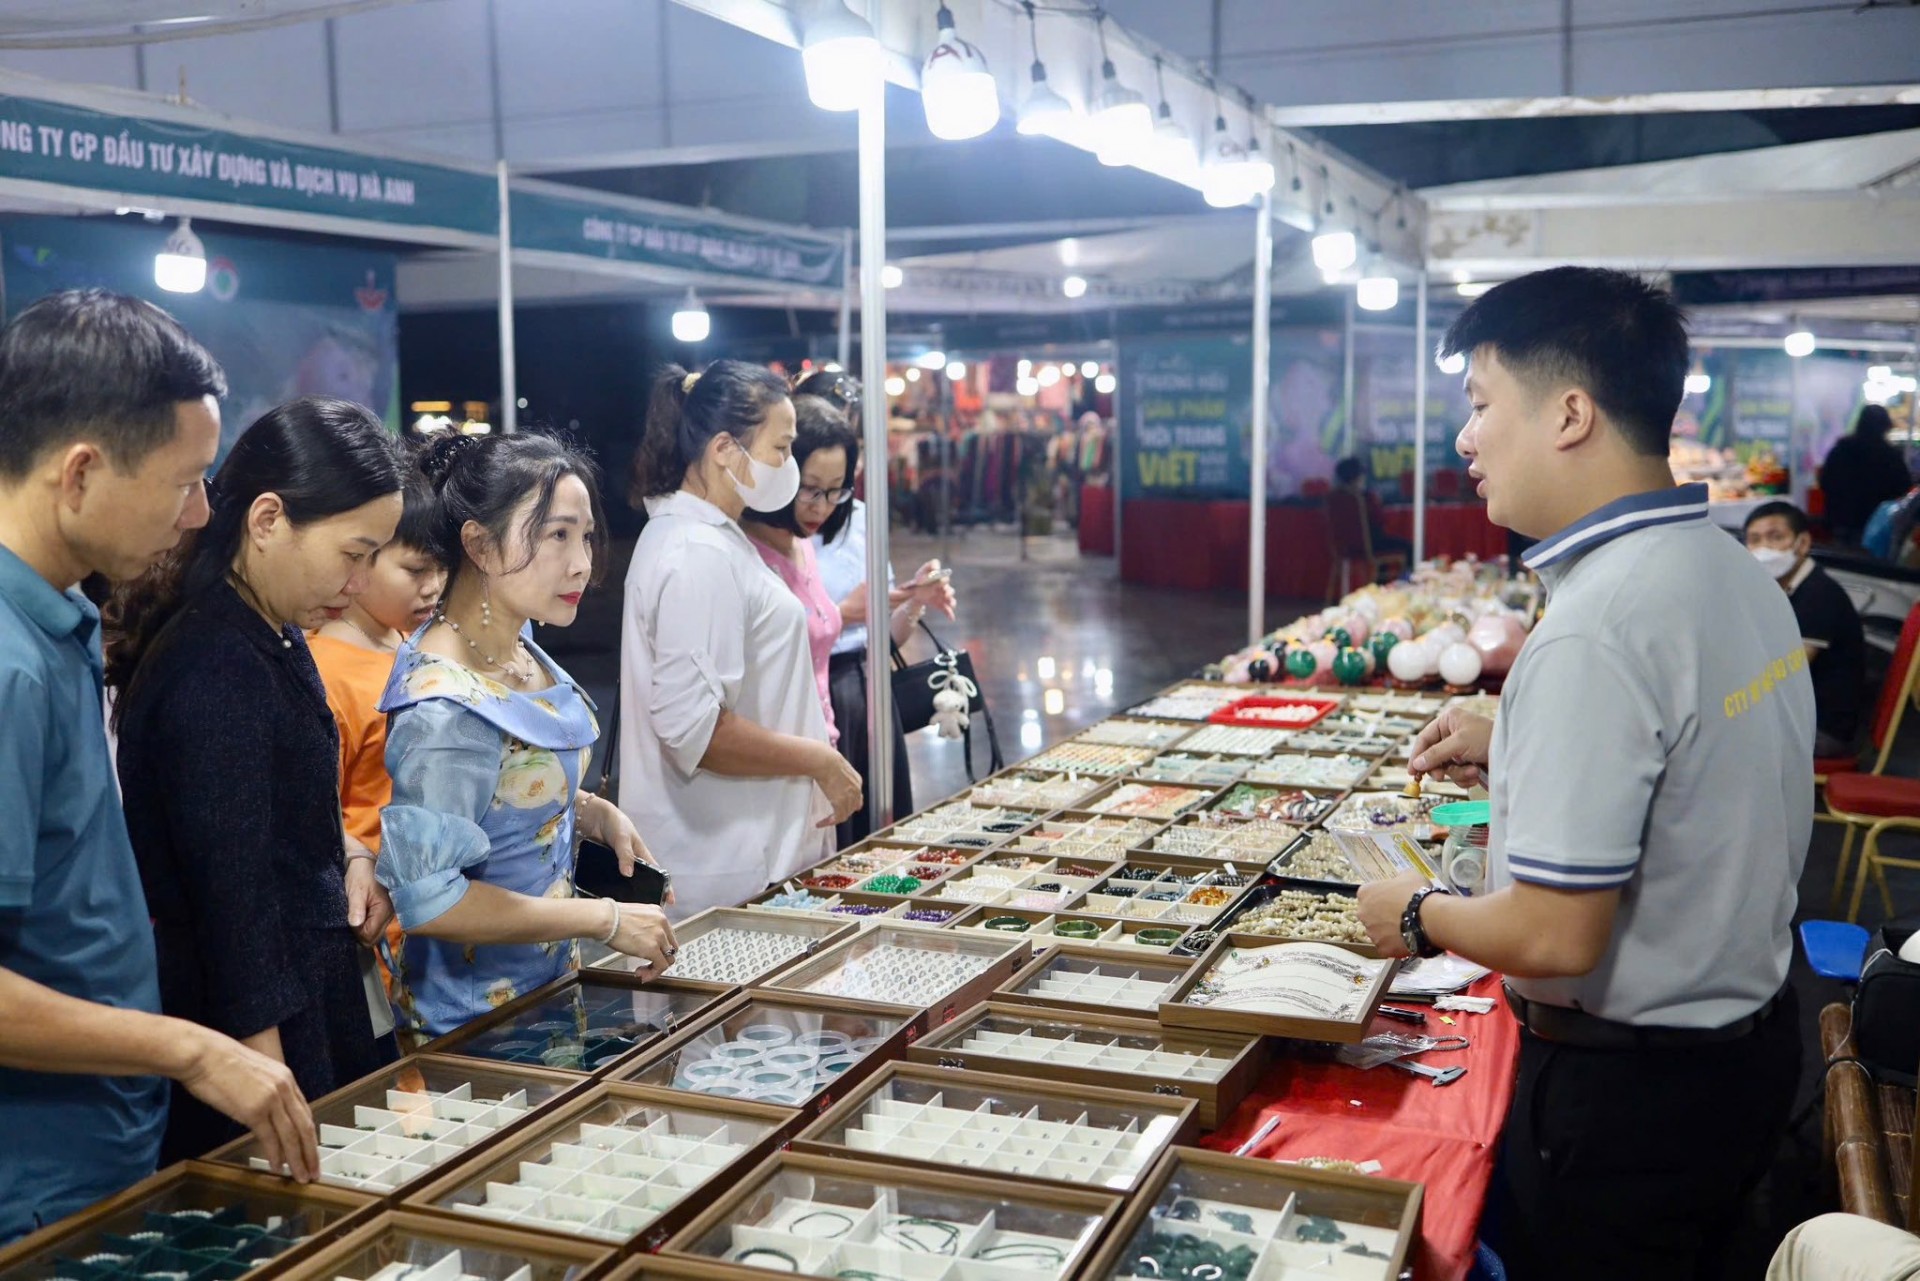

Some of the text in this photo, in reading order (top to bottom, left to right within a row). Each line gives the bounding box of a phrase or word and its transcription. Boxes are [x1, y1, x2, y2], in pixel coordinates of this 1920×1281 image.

[38, 125, 64, 157] TY
[69, 130, 98, 162] CP
[103, 128, 144, 169] ĐẦU
[148, 142, 175, 172] TƯ
[177, 143, 214, 179] XÂY
[217, 152, 267, 188] DỰNG
[269, 156, 294, 189] VÀ
[294, 164, 334, 198] DỊCH
[335, 170, 359, 202] VỤ
[384, 177, 415, 205] ANH
